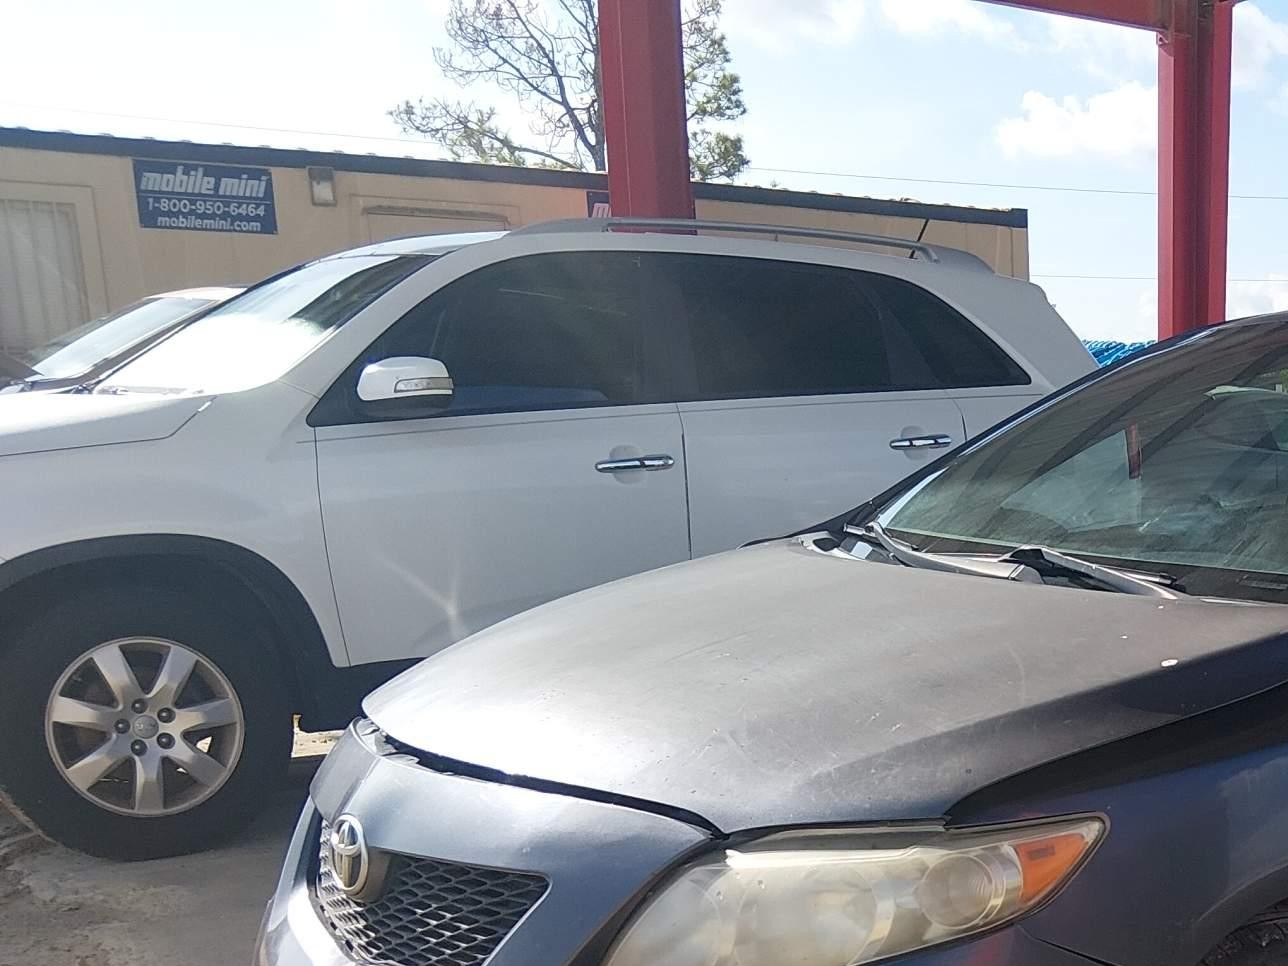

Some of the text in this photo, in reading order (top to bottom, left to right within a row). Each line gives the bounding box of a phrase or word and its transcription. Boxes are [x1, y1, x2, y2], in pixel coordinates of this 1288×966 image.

[140, 165, 269, 198] mobile mini
[147, 198, 266, 217] 1-800-950-6464
[157, 214, 262, 232] mobilemini.com
